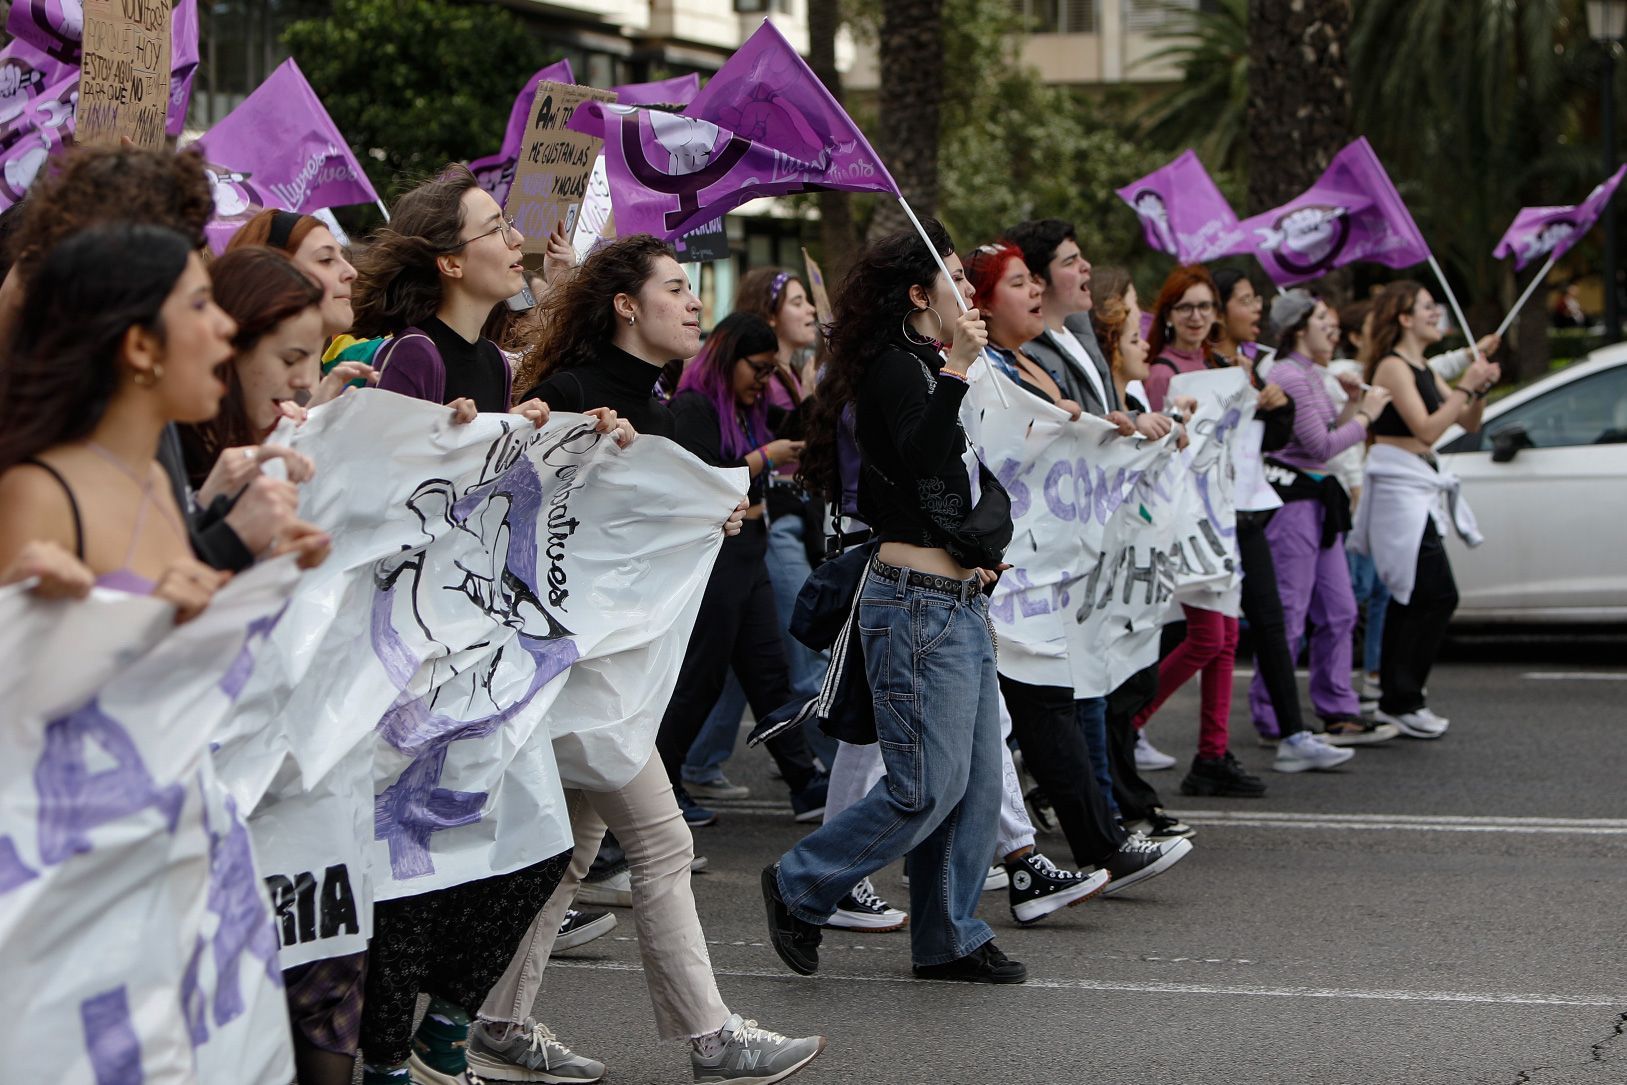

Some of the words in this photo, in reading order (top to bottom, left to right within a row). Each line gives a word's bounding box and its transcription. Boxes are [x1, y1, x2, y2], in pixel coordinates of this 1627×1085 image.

[136, 35, 162, 71] HOY
[106, 84, 127, 104] QUE
[129, 74, 143, 103] NO
[528, 141, 544, 164] ME
[542, 142, 575, 165] GUSTAN
[572, 146, 590, 167] LAS
[570, 171, 589, 198] LAS
